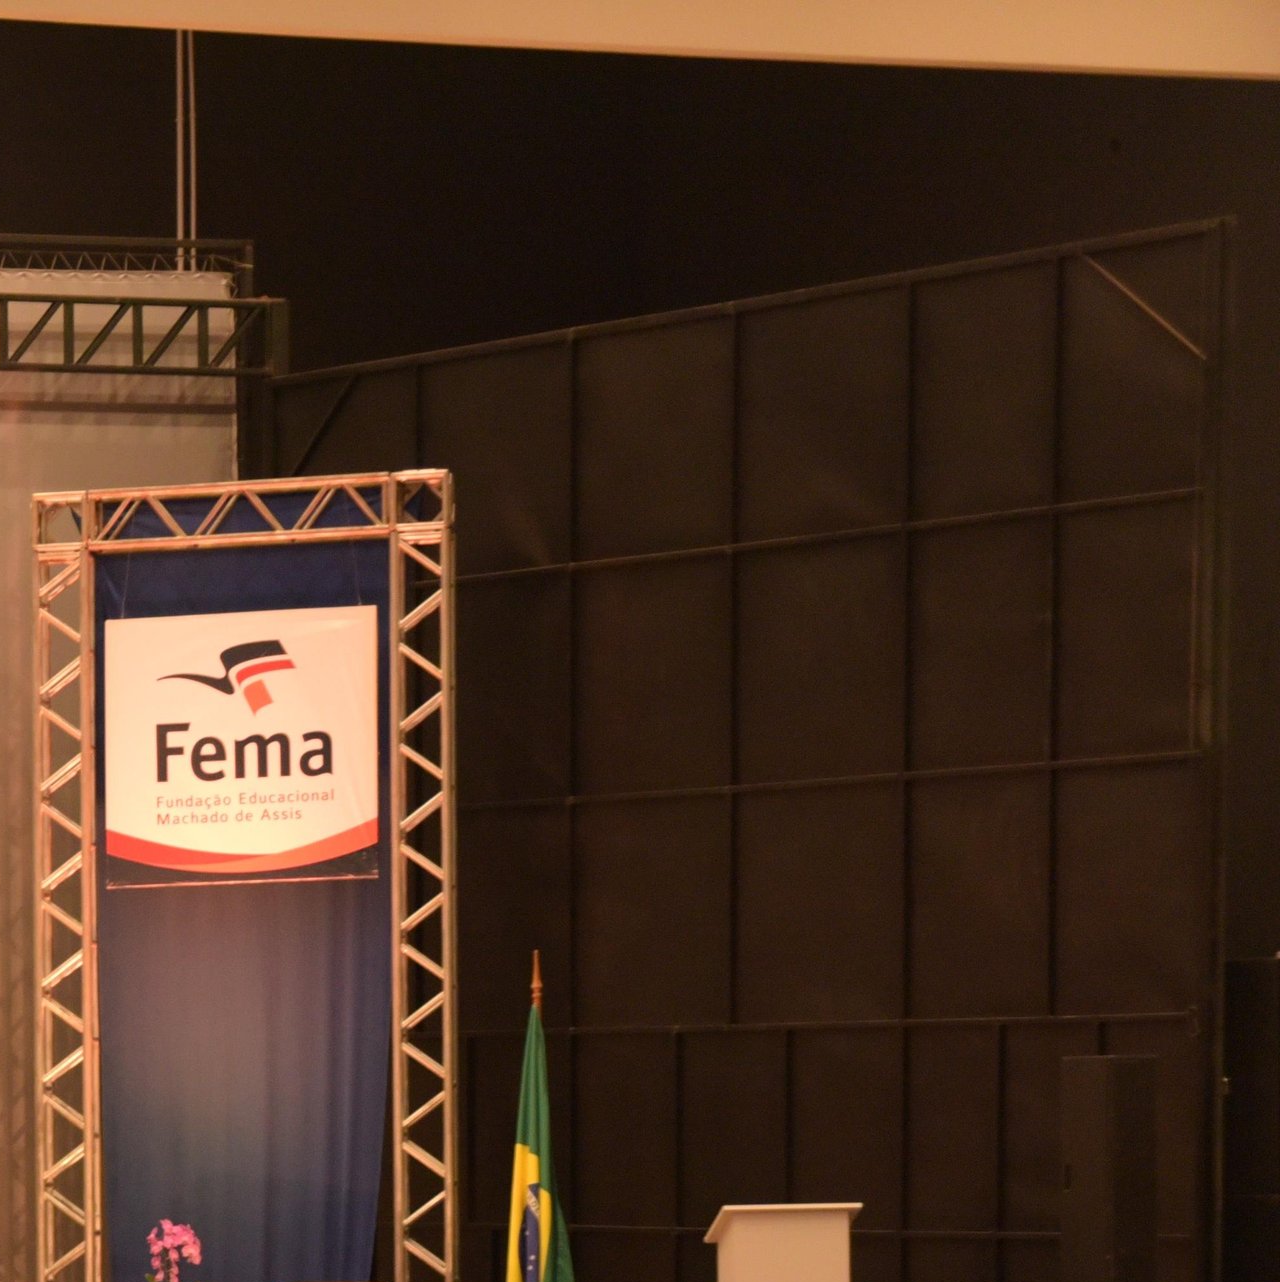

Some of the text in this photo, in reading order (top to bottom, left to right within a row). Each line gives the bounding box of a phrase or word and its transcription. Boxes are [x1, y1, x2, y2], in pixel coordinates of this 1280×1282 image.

[156, 722, 333, 782] Fema
[156, 788, 336, 810] Fundação Educacional
[156, 808, 303, 826] Machado de Assis
